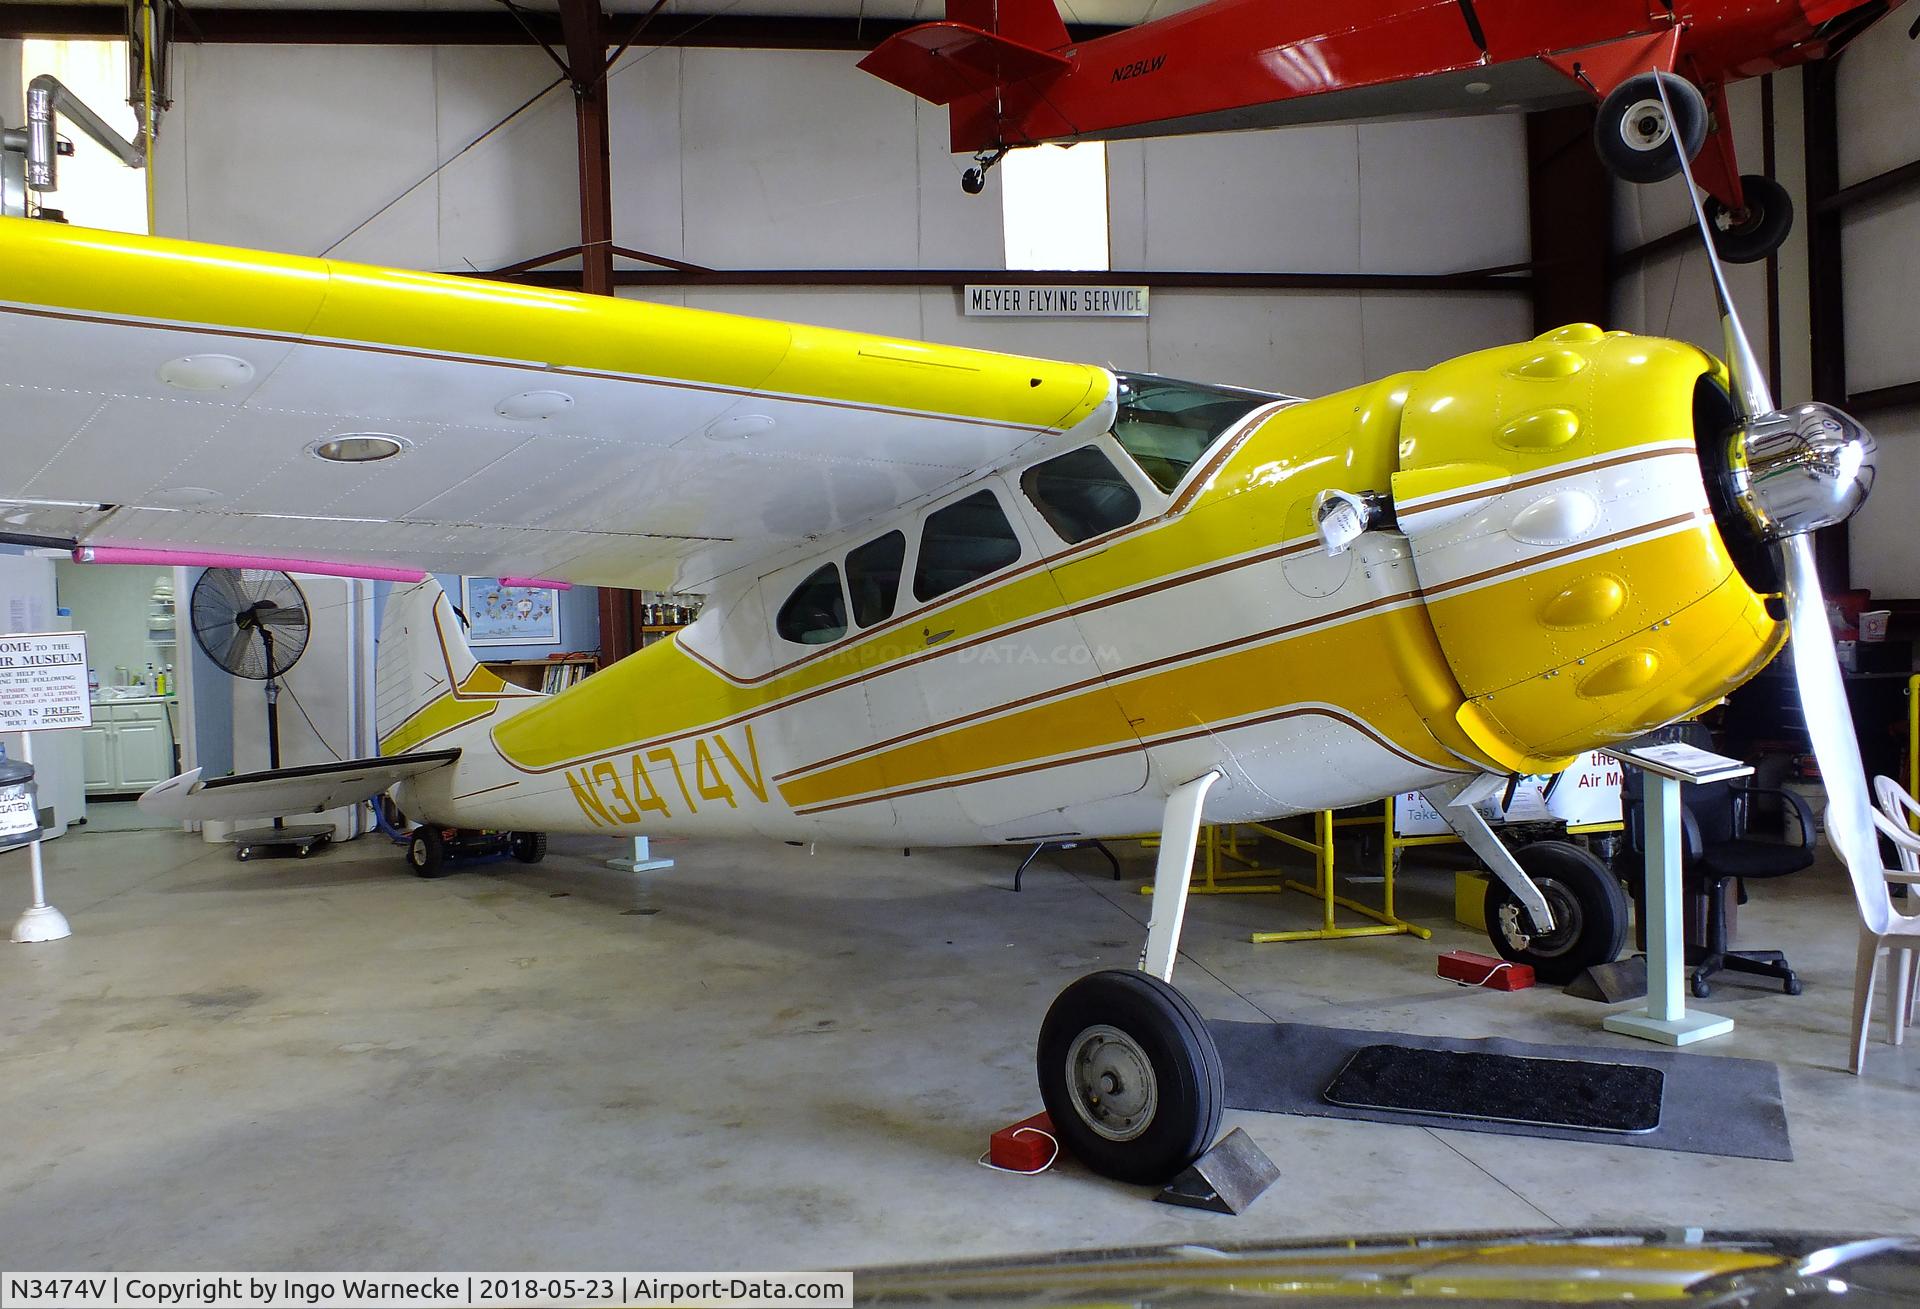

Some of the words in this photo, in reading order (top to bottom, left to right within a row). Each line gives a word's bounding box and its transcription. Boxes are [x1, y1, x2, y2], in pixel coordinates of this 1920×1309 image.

[1111, 54, 1167, 83] N28LW
[972, 289, 1021, 311] MEYER
[1029, 290, 1077, 311] FLYING
[1084, 290, 1142, 311] SERVICE
[52, 643, 70, 651] THE
[22, 653, 82, 665] MUSEUM
[51, 695, 81, 703] AIRCRAFT
[28, 707, 39, 716] IS
[1592, 752, 1615, 766] the
[565, 725, 768, 828] N3474V
[1579, 772, 1601, 788] Air
[1408, 809, 1438, 821] Take
